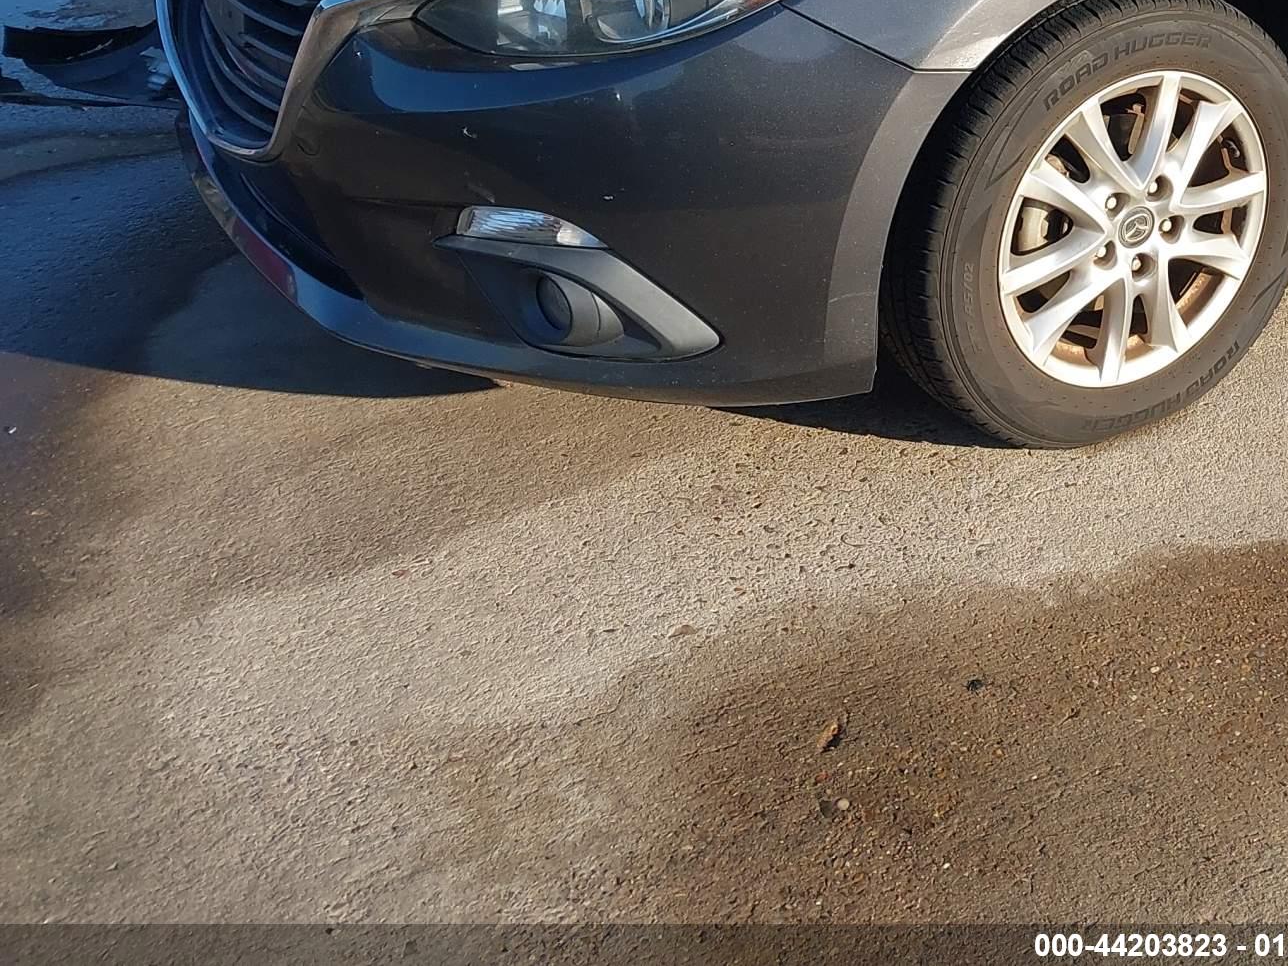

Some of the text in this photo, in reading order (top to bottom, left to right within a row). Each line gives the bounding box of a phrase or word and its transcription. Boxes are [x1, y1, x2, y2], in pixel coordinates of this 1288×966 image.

[1043, 32, 1213, 112] ROAD HUGGER
[1186, 340, 1241, 398] ROAD
